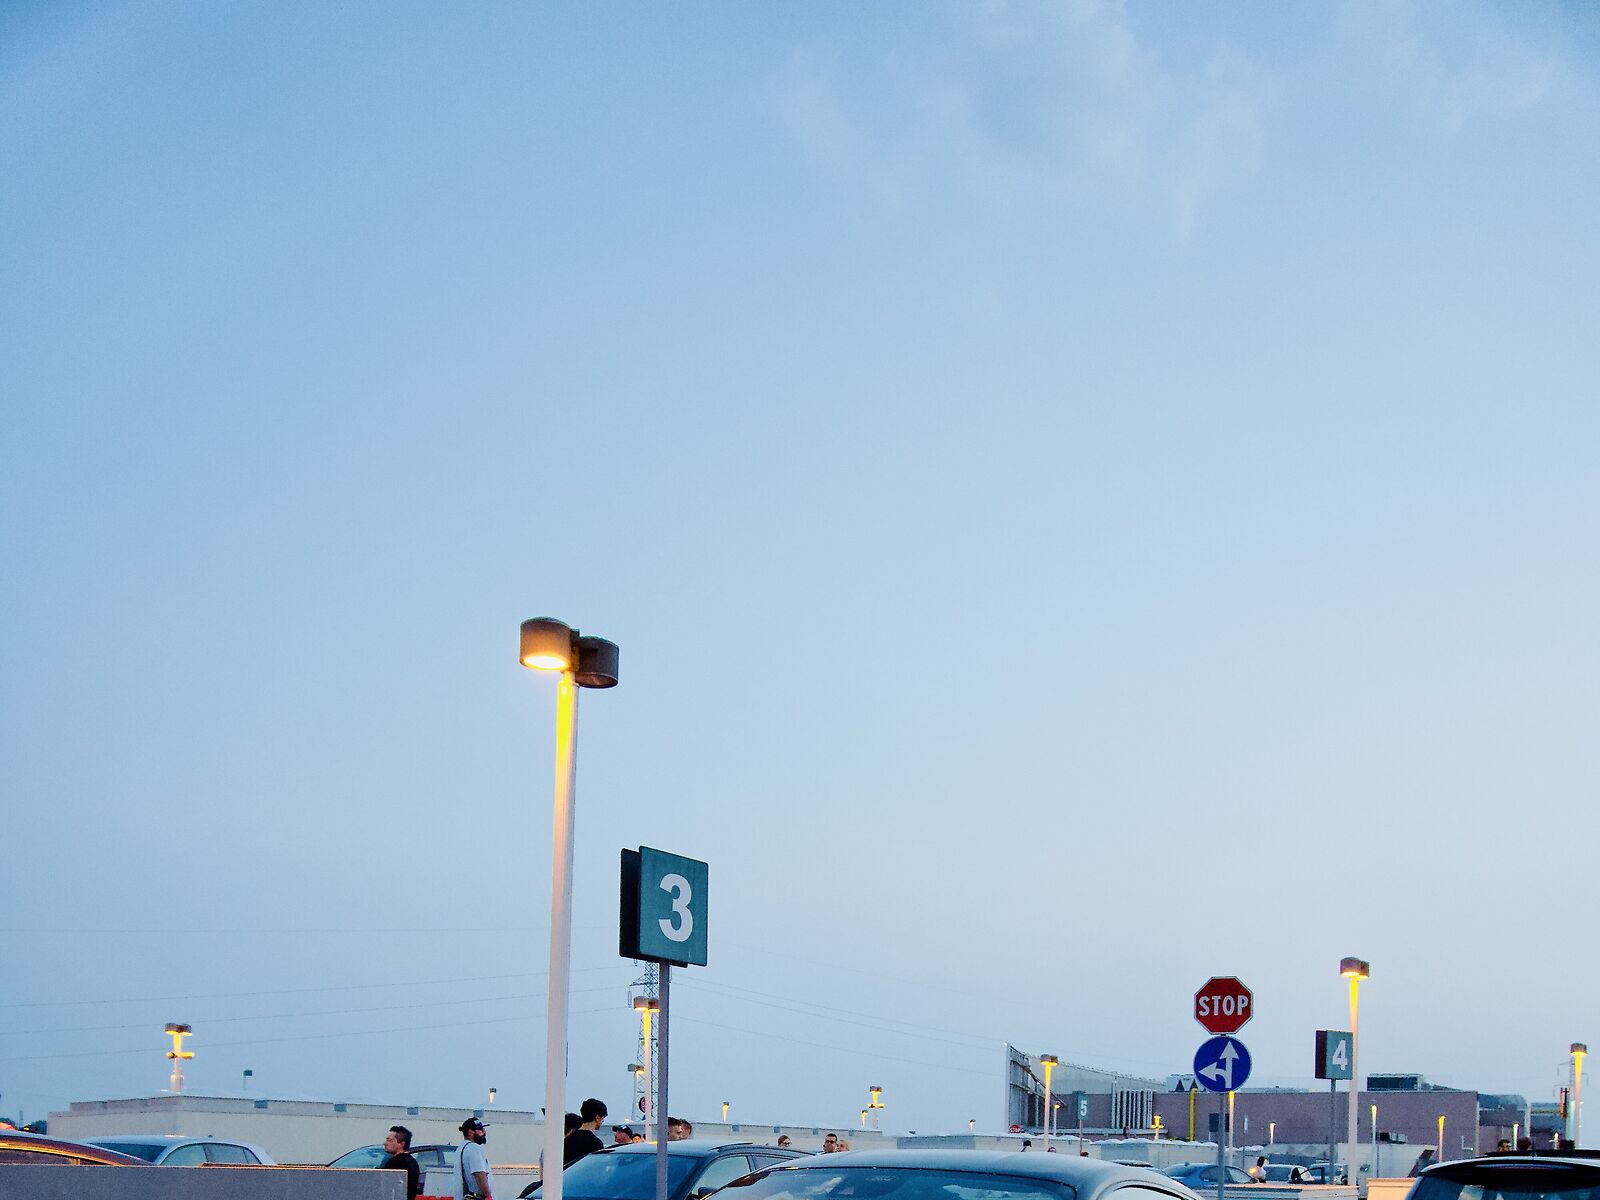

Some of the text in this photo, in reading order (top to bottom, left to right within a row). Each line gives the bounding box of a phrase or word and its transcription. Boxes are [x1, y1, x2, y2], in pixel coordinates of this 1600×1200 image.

[658, 873, 694, 942] 3
[1199, 995, 1249, 1016] STOP
[1332, 1039, 1348, 1071] 4
[1080, 1099, 1088, 1117] 5
